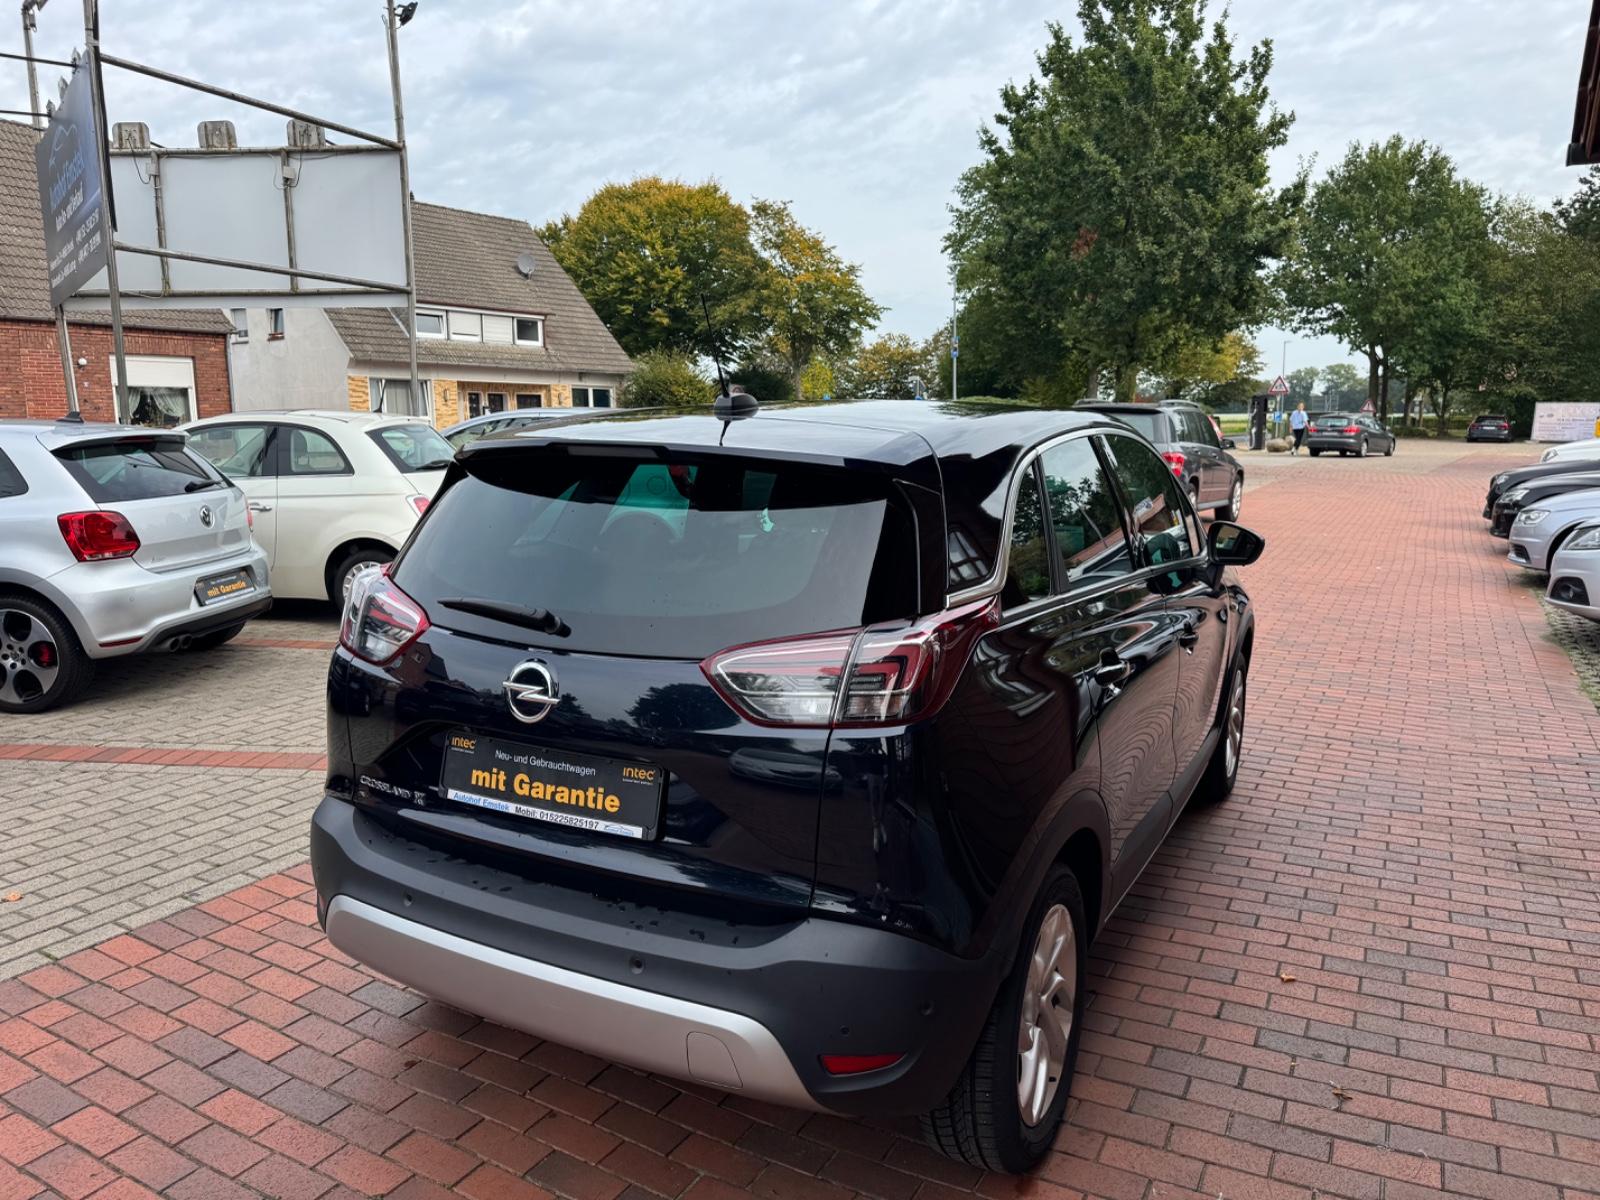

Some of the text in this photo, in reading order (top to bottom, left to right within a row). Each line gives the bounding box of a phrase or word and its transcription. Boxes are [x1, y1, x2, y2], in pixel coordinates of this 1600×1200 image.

[207, 586, 220, 597] mit
[220, 580, 246, 594] Garantie
[495, 749, 596, 777] Neu- und Gebrauchtwagen
[471, 767, 621, 813] mit Garantie
[453, 792, 481, 805] Autohof
[515, 805, 537, 818] Mobil:
